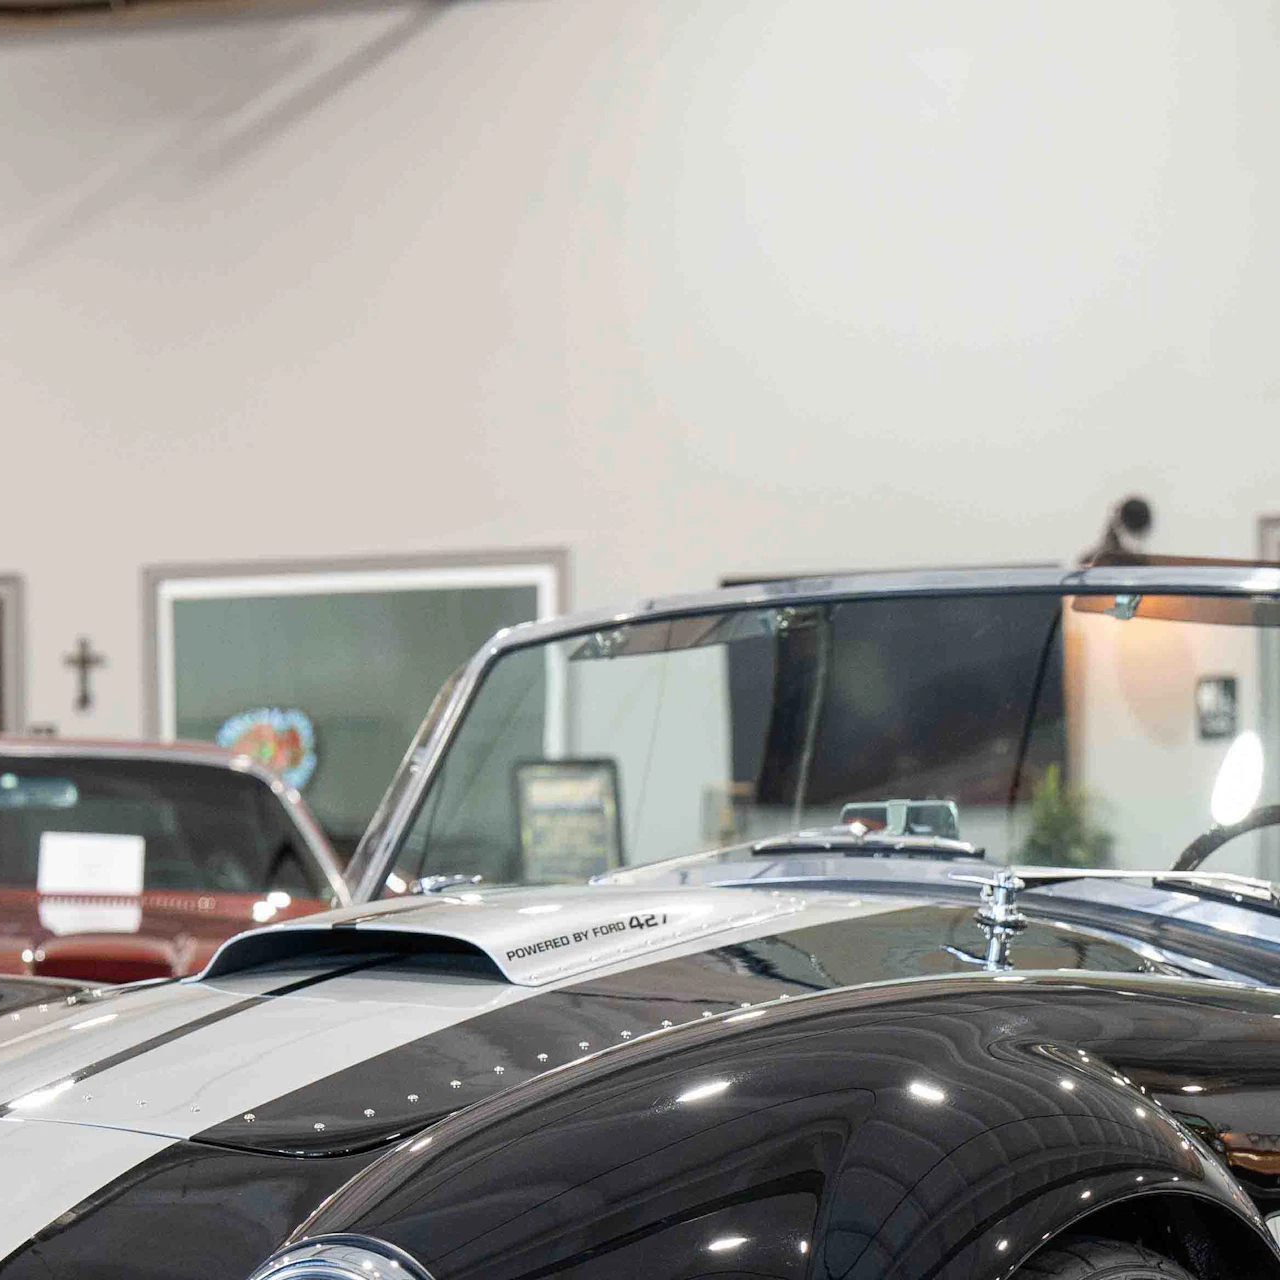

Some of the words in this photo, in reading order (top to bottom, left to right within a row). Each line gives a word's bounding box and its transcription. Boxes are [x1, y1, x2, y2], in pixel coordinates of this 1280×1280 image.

[506, 935, 570, 961] POWERED
[572, 929, 589, 943] BY
[592, 921, 626, 938] FORD
